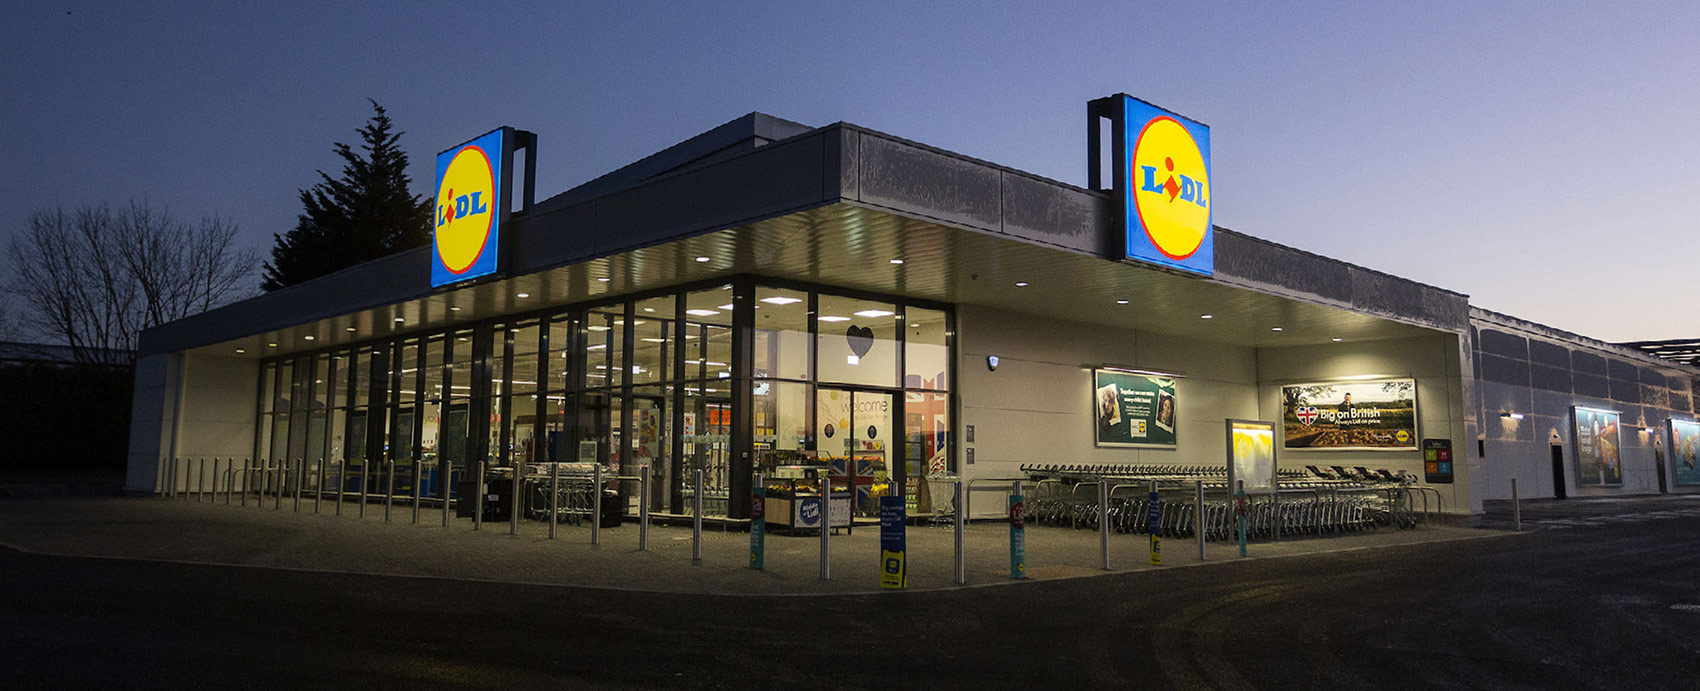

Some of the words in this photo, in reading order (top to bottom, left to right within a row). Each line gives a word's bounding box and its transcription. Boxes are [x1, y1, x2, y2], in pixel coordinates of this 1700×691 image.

[1320, 408, 1336, 422] Big
[1337, 411, 1350, 419] on
[1351, 407, 1381, 419] British
